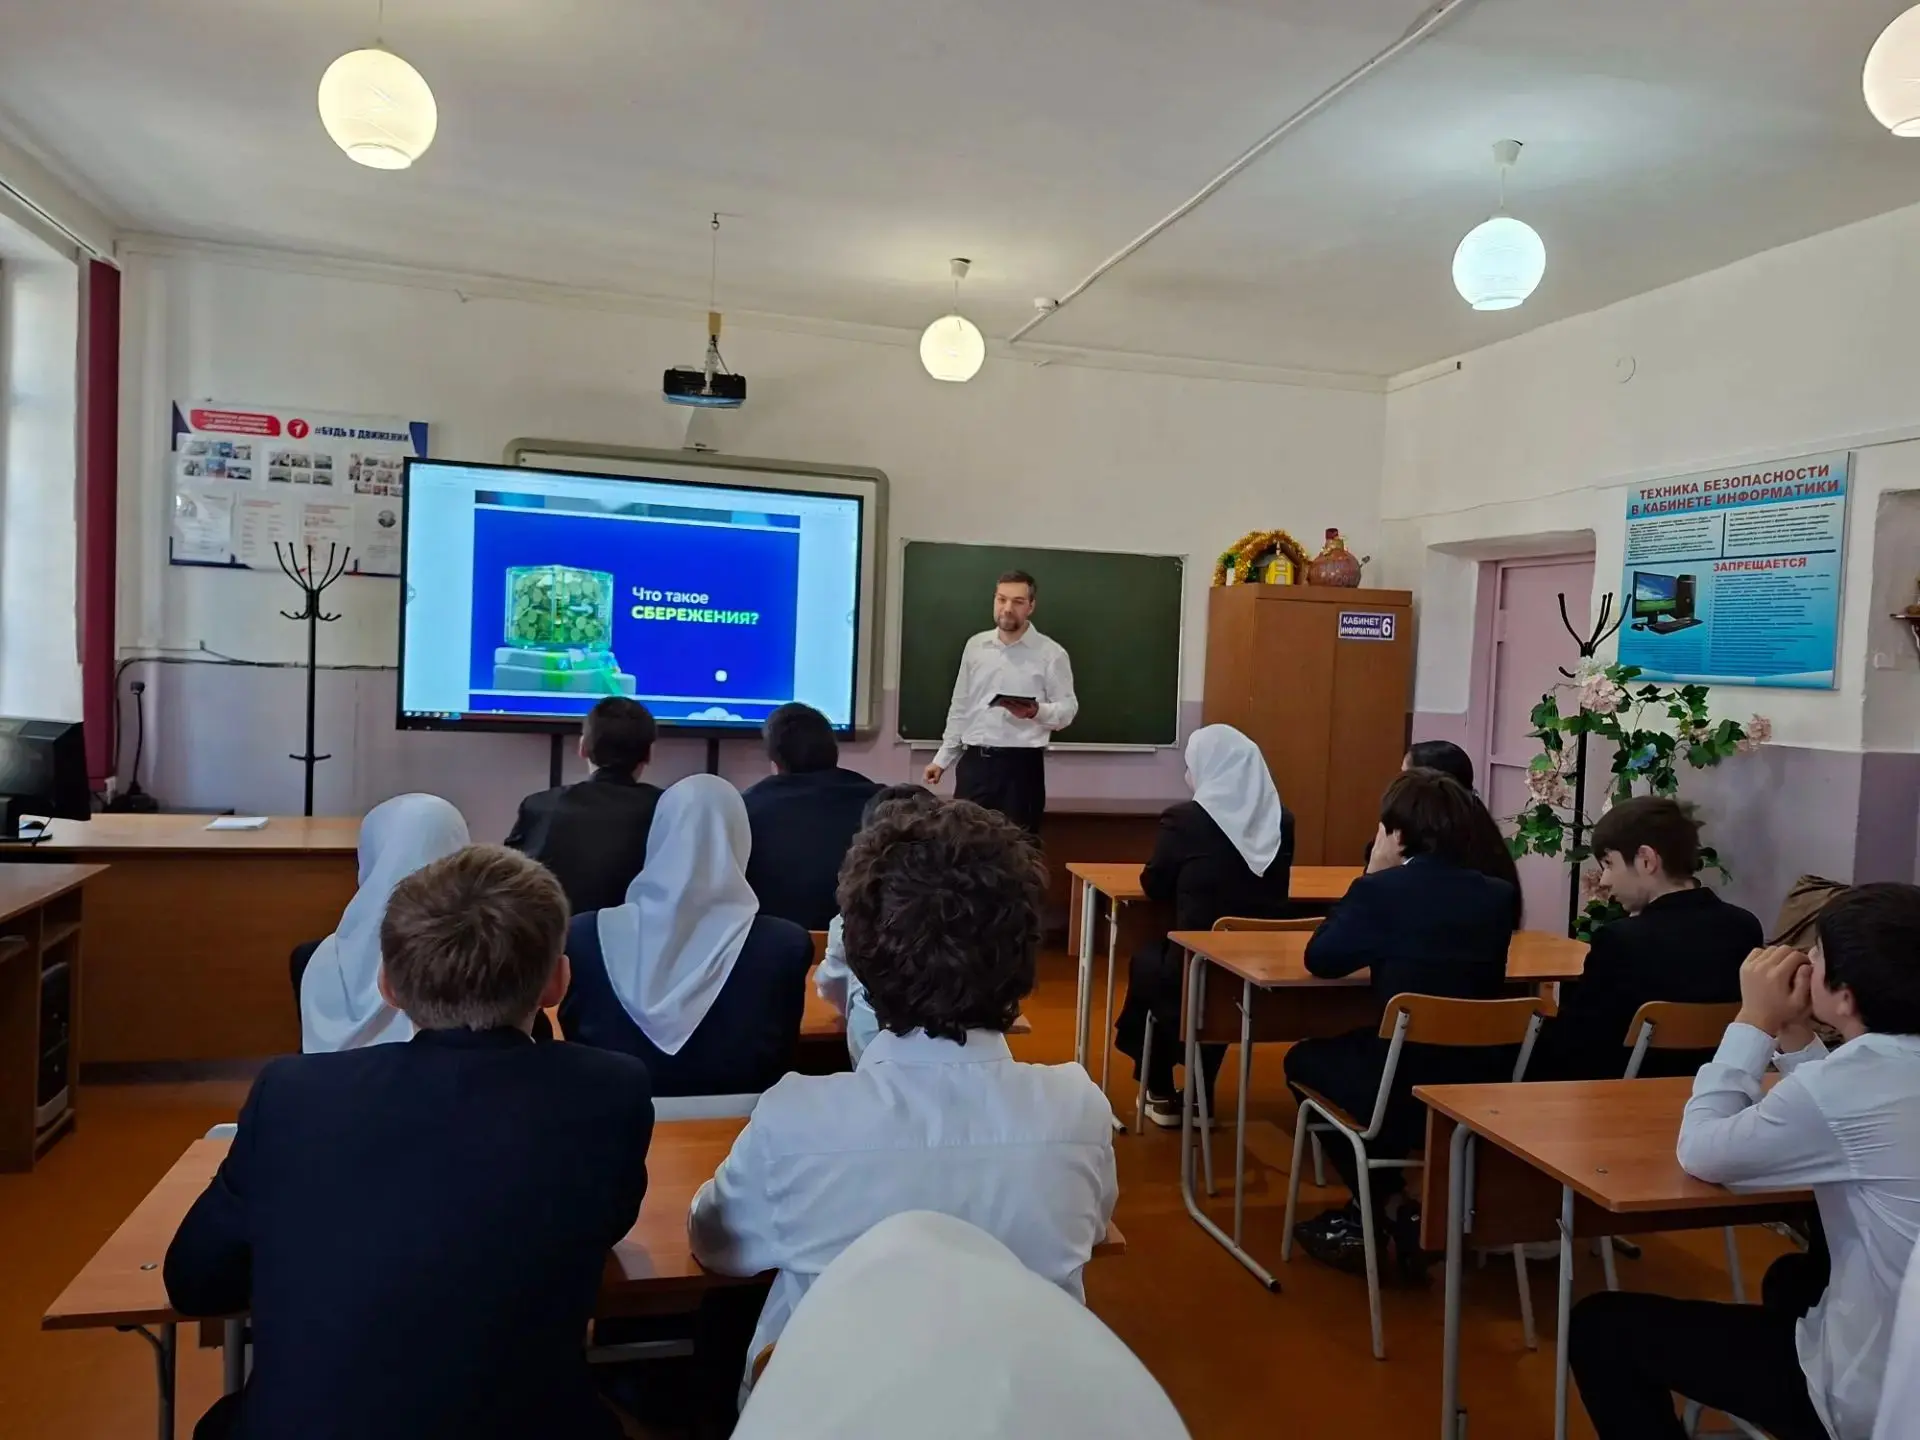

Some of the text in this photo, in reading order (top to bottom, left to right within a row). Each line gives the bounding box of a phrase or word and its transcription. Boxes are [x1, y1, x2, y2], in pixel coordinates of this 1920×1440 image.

[349, 429, 356, 438] В
[1640, 464, 1830, 500] ТЕХНИКА БЕЗОПАСНОСТИ
[1631, 479, 1839, 515] В КАБИНЕТЕ ИНФОРМАТИКИ
[1713, 556, 1807, 572] ЗАПРЕЩАЕТСЯ
[632, 586, 709, 604] Что такое
[631, 605, 760, 625] СБЕРЕЖЕНИЯ?
[1343, 616, 1380, 626] КАБИНЕТ
[1341, 626, 1380, 636] ИНФОРМАТИКИ
[1382, 617, 1392, 637] 6
